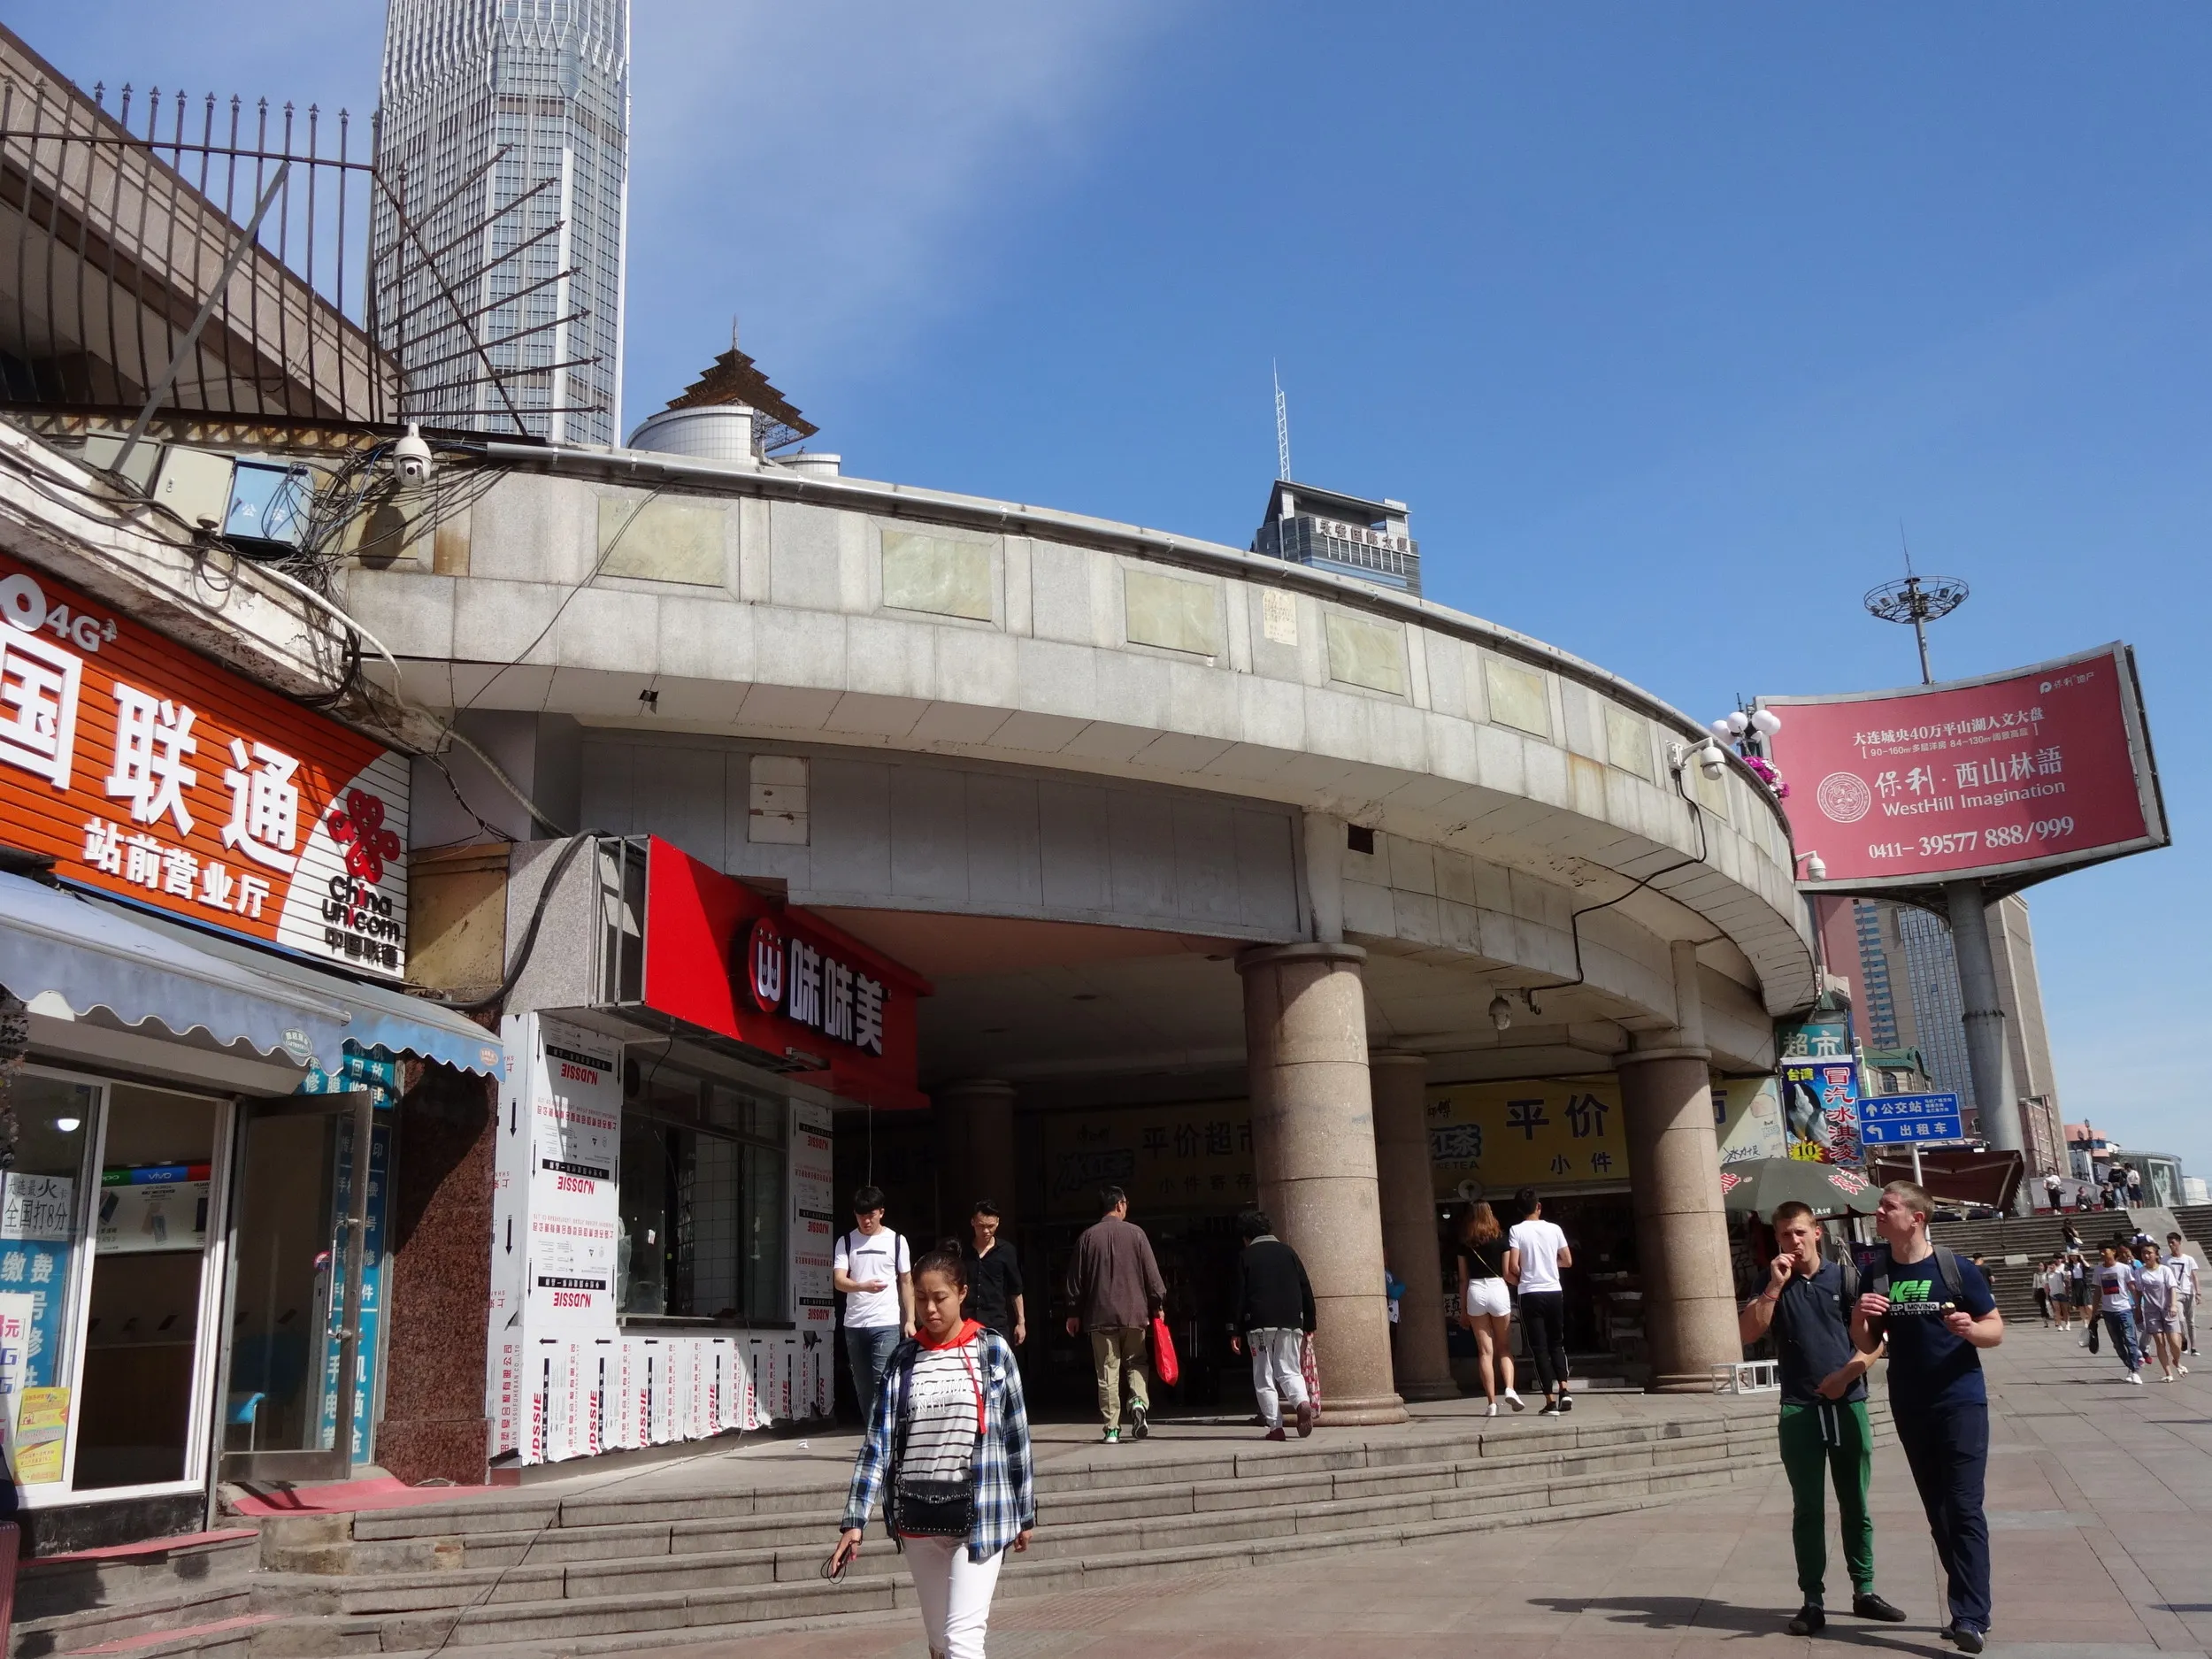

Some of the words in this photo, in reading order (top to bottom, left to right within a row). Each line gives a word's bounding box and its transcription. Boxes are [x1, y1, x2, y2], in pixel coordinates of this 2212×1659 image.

[1853, 707, 2045, 746] 大连城央40万平山湖人文大盘
[1882, 795, 1954, 817] WestHill
[1962, 780, 2066, 809] Imagination
[1919, 831, 1978, 856] 39577
[1985, 816, 2075, 849] 888/999
[83, 817, 270, 918] 站前营业厅
[329, 875, 393, 917] China
[322, 898, 400, 942] unicom
[325, 927, 398, 969] 中国联通
[790, 938, 882, 1055] 味味美
[1783, 1031, 1841, 1058] 超市
[1786, 1067, 1814, 1081] 台湾
[1507, 1093, 1609, 1141] 平价
[1881, 1102, 1922, 1115] 公交站
[1900, 1122, 1947, 1136] 出租车
[1550, 1152, 1612, 1175] 小件
[557, 1176, 595, 1194] NJDSSIE
[4, 1198, 68, 1231] 全国打8分
[553, 1292, 591, 1308] NJDSSIE
